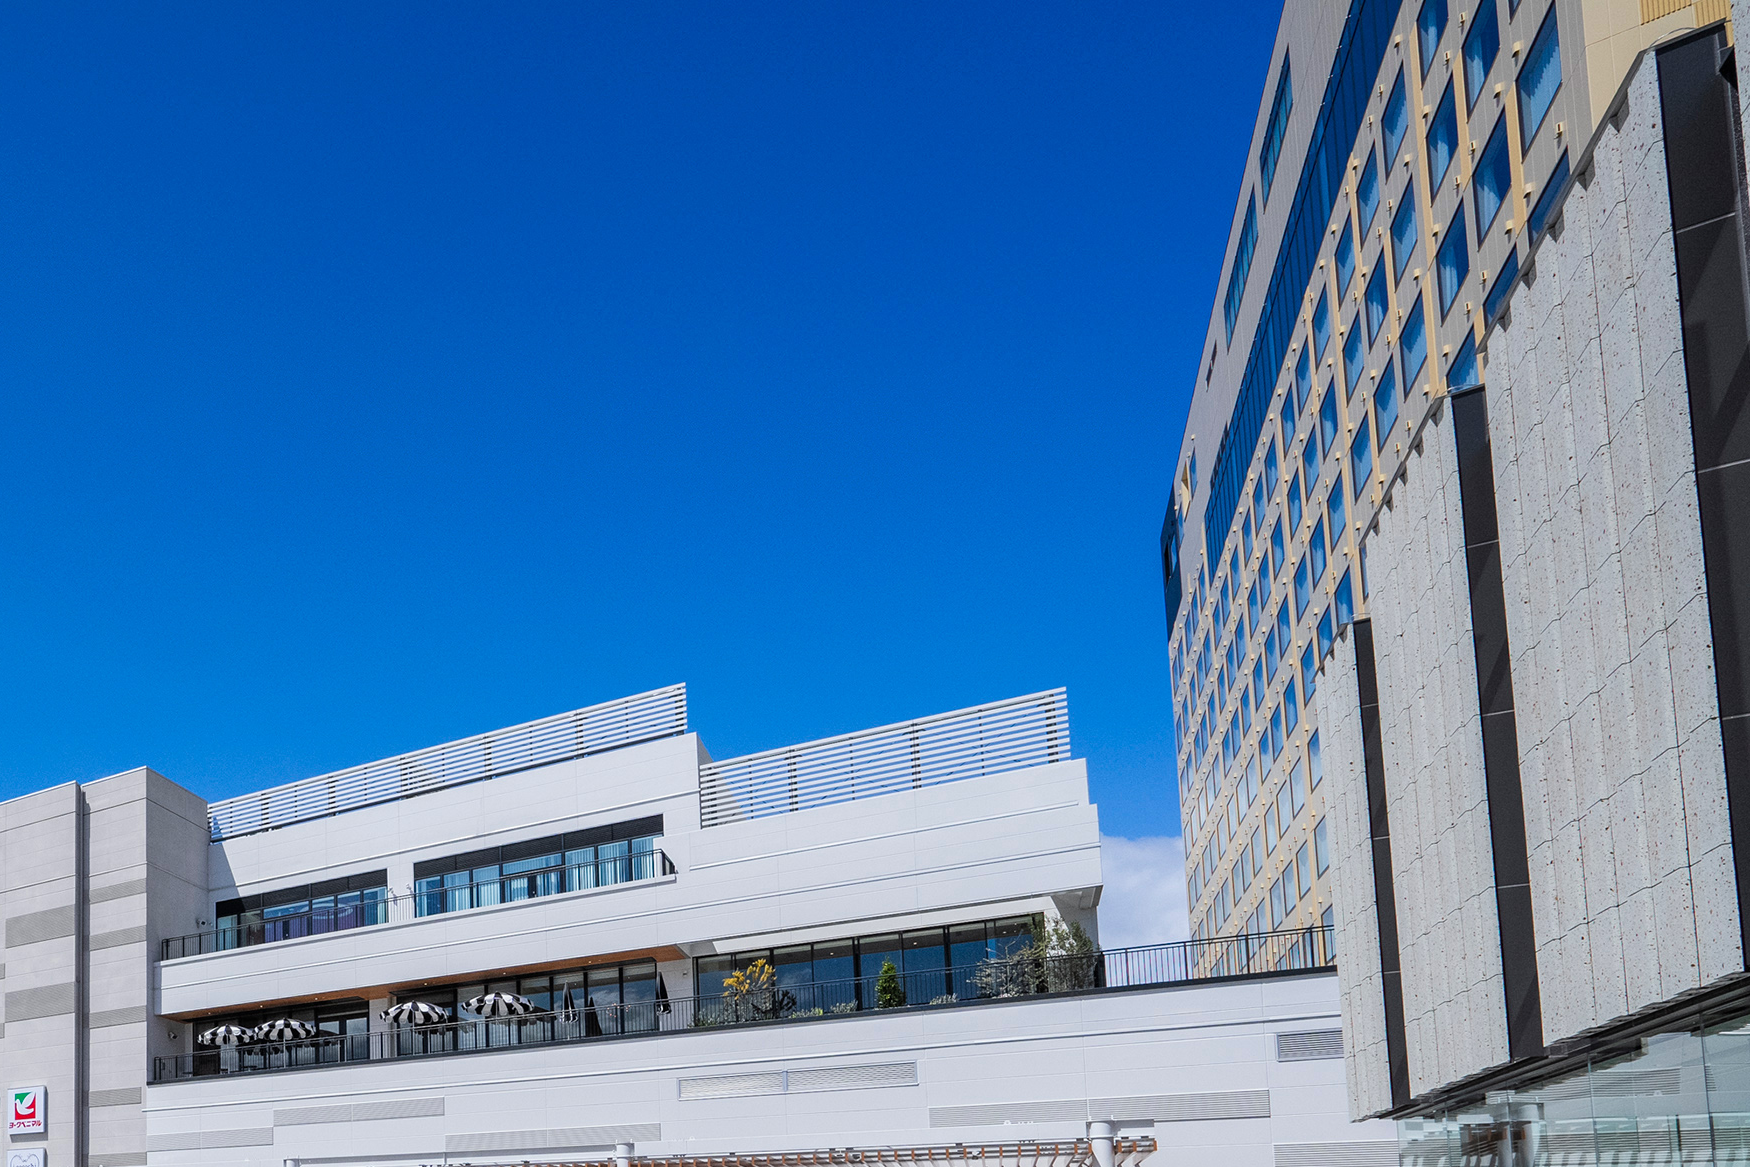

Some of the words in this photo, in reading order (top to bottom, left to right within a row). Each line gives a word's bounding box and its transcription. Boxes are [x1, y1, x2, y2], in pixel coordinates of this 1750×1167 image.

[8, 1120, 42, 1128] ヨークベニマル
